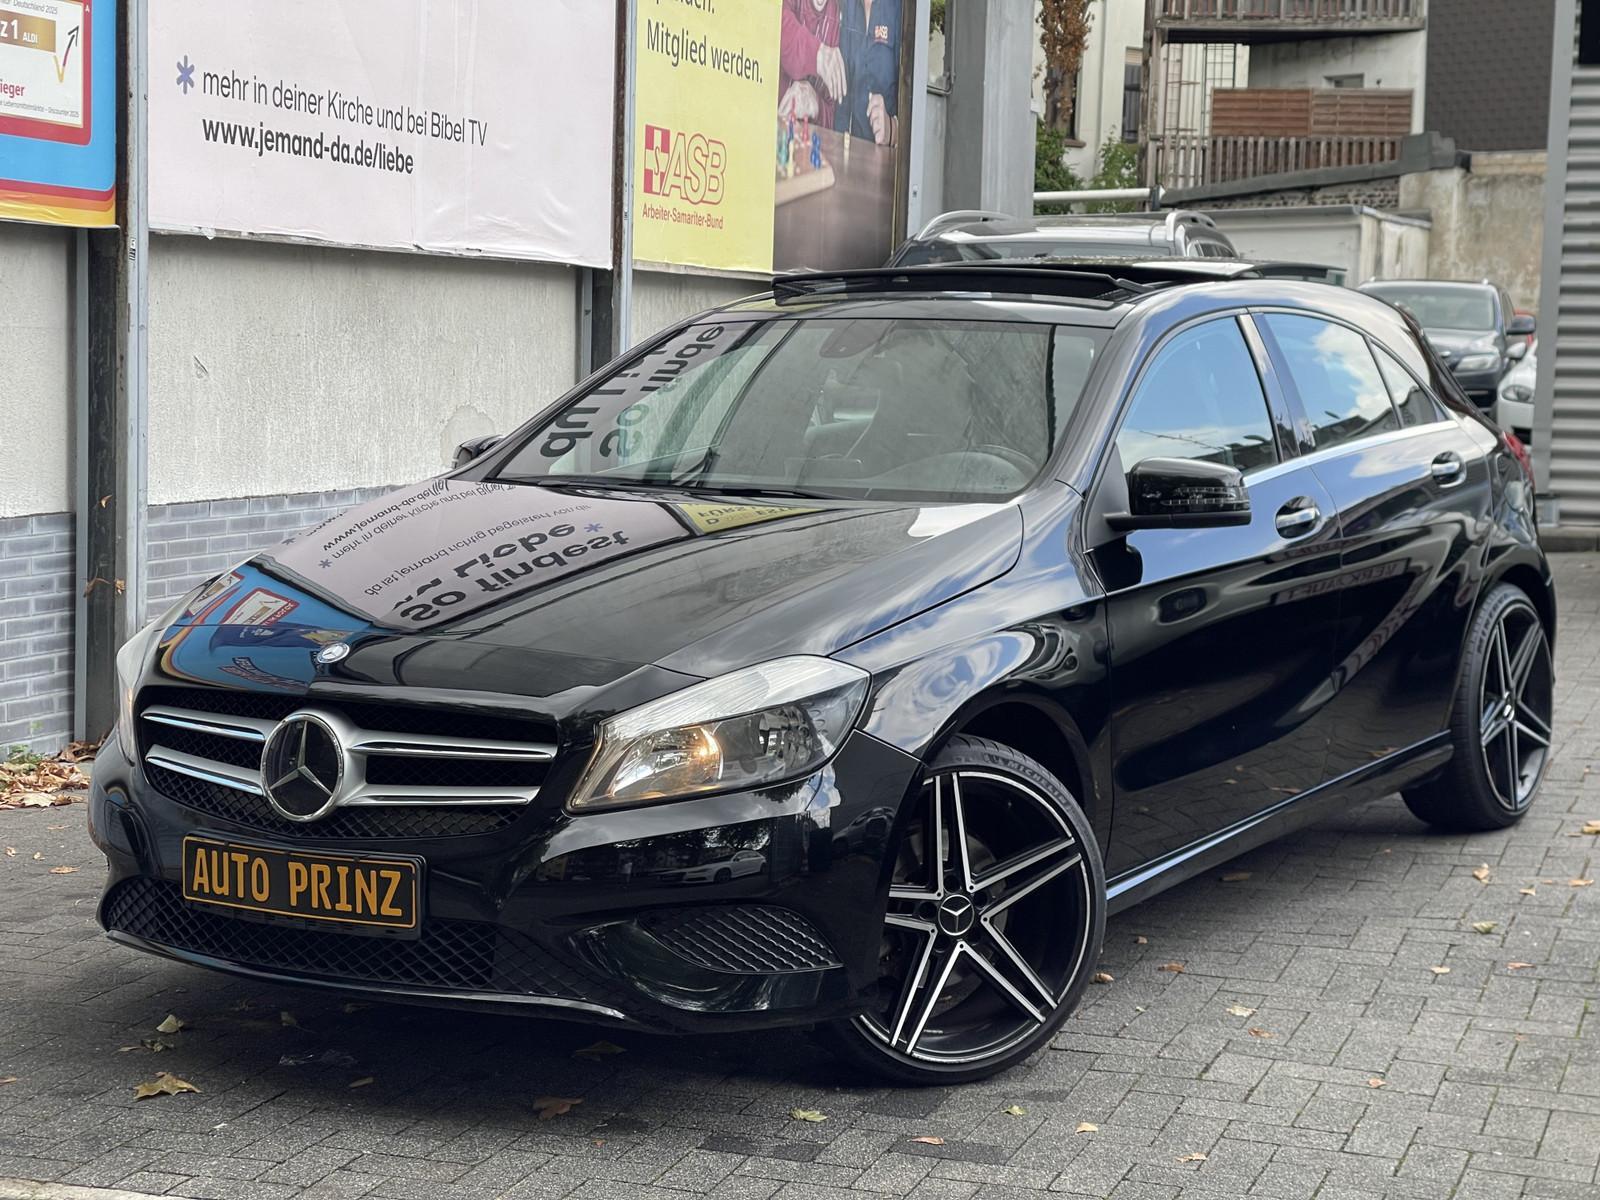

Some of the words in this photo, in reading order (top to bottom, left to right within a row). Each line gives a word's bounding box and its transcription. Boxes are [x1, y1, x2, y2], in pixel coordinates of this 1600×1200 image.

[647, 18, 706, 67] Mitglied
[710, 47, 763, 84] werden.
[202, 69, 249, 101] mehr
[253, 75, 268, 105] in
[272, 80, 323, 115] deiner
[327, 89, 373, 126] Kirche
[376, 105, 403, 131] und
[407, 107, 427, 136] bei
[431, 112, 465, 142] Bibel
[468, 119, 488, 146] TV
[202, 118, 414, 174] www.jemand-da.de/liebe
[661, 132, 727, 206] ASB
[642, 202, 724, 229] Arbeiter-Samariter-Bund
[1007, 760, 1067, 804] MICHELIN
[192, 848, 270, 902] AUTO
[287, 861, 402, 917] PRINZ
